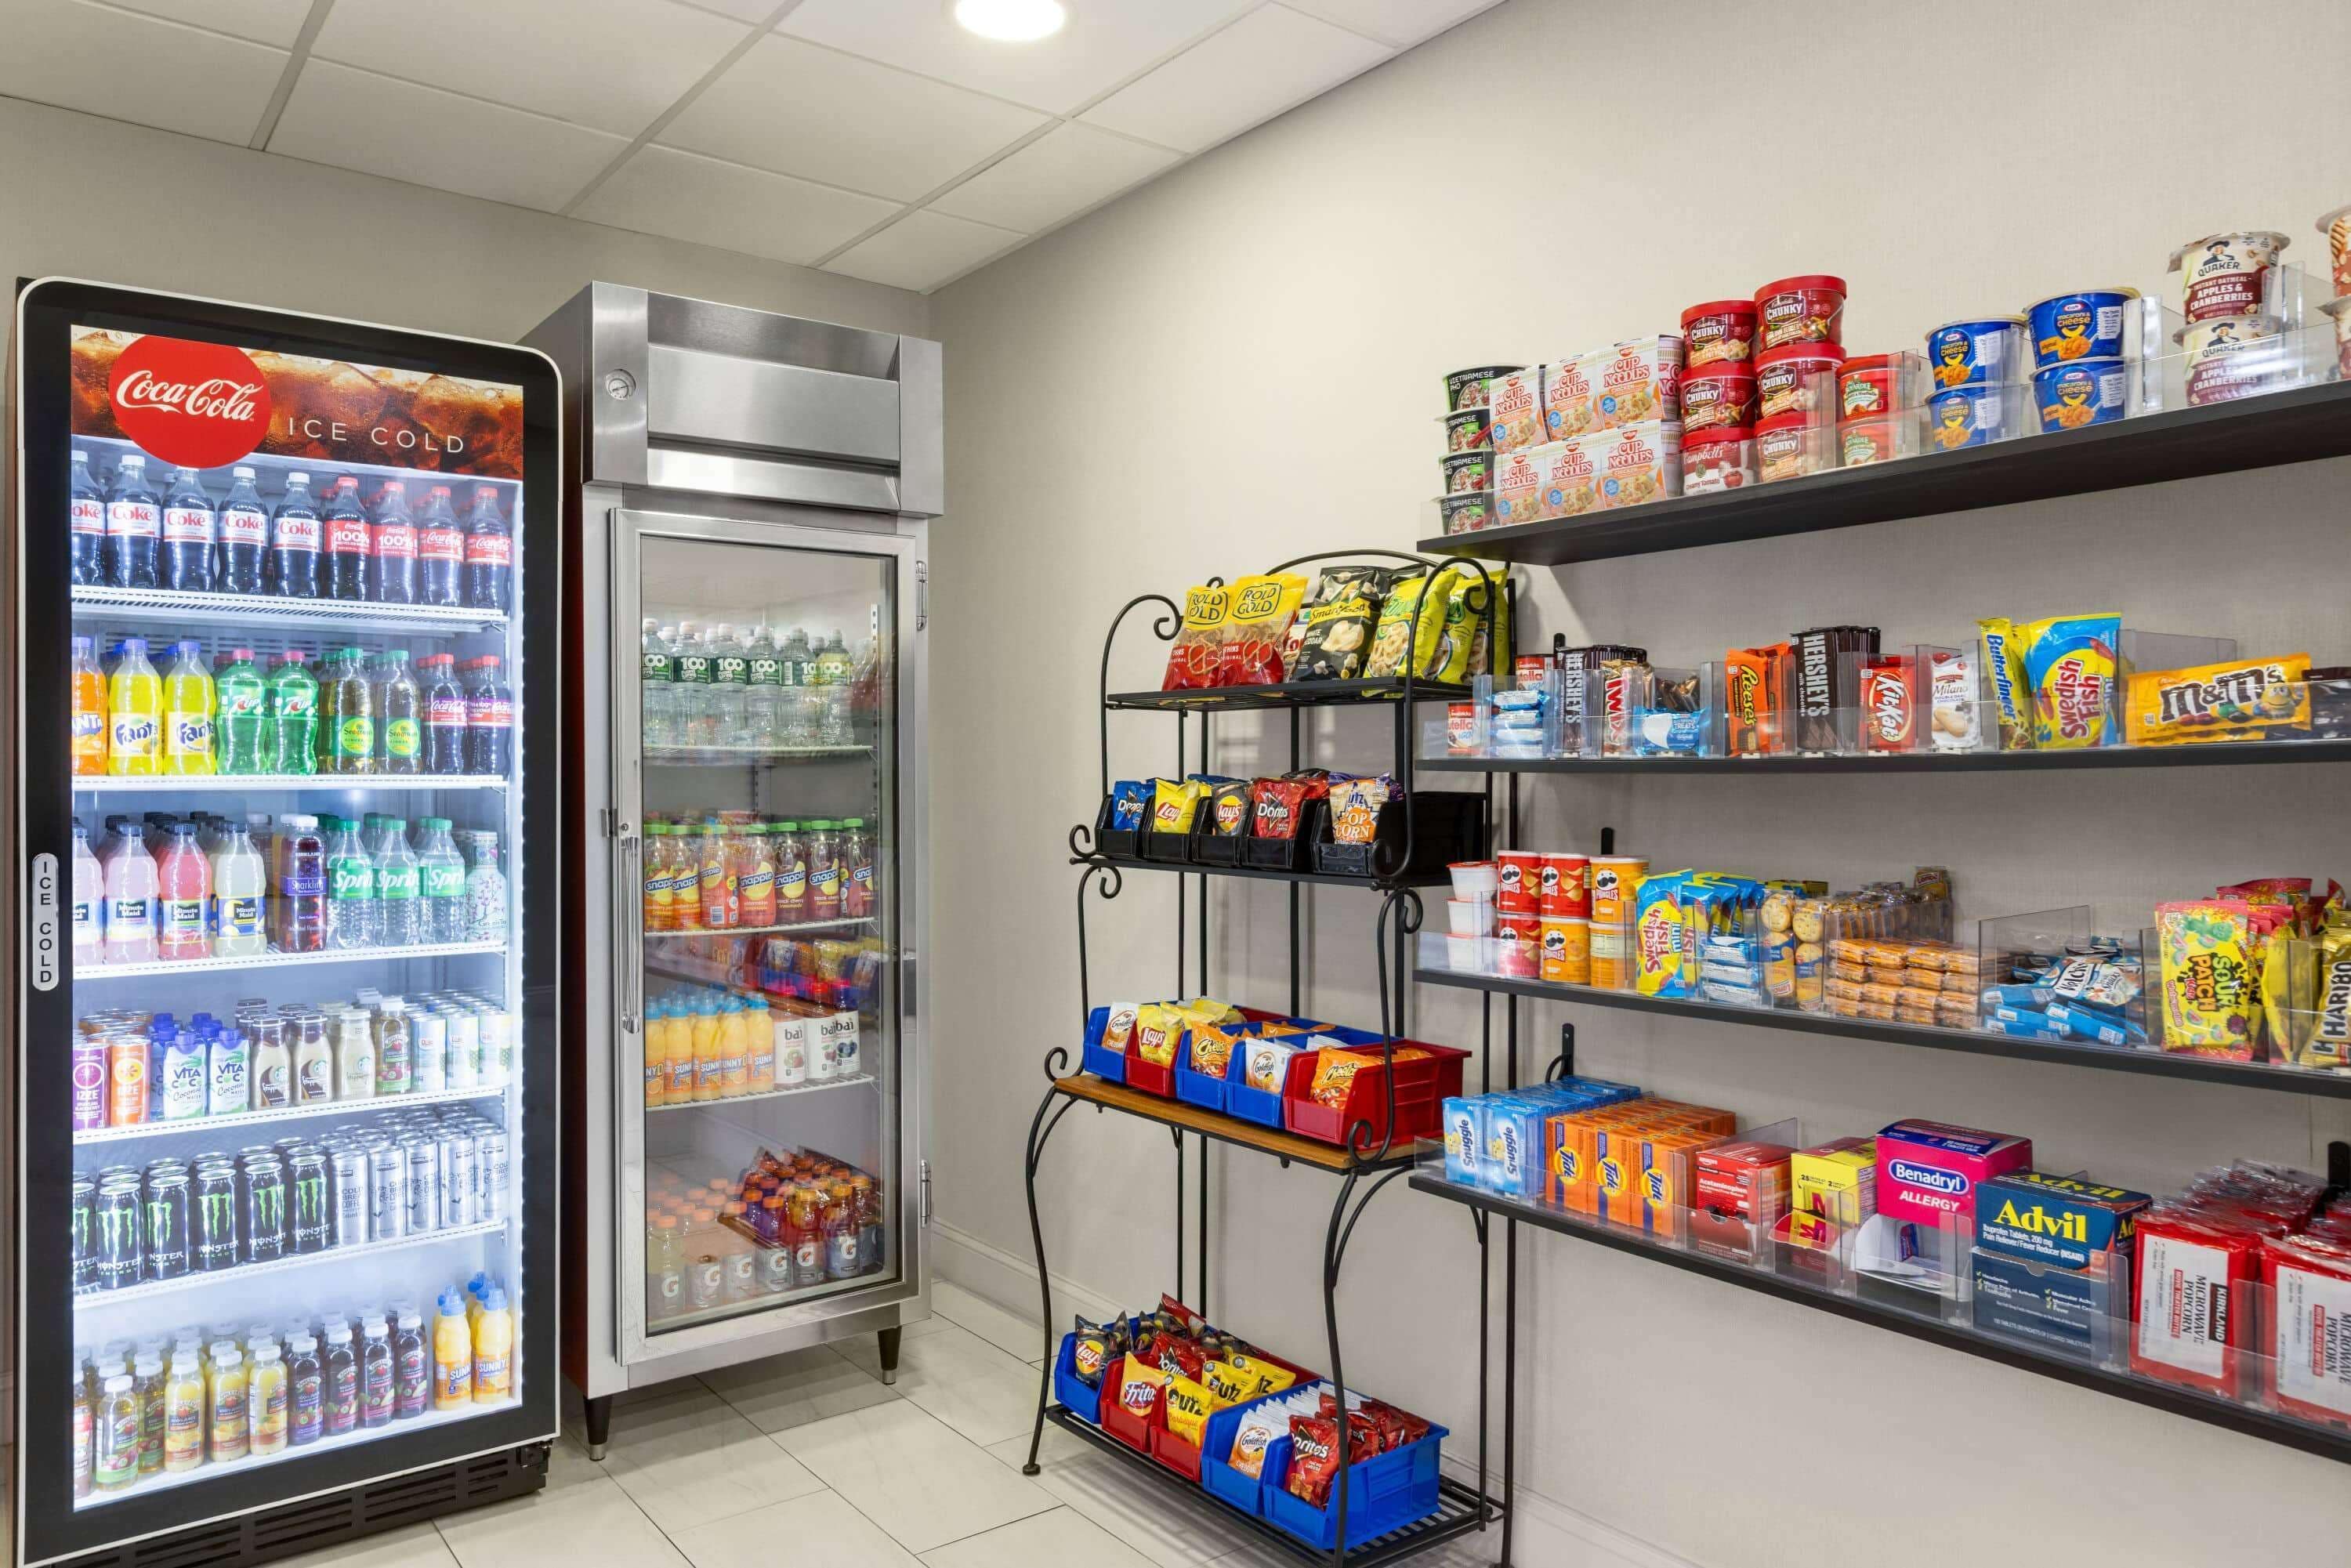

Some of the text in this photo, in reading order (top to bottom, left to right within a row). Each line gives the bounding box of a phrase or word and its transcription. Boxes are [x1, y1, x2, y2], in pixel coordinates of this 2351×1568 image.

[2198, 262, 2241, 277] QUAKER
[2218, 276, 2248, 285] OATMEAL
[2197, 283, 2243, 299] APPLES &
[1766, 302, 1803, 320] CHUNKY
[2190, 293, 2254, 310] CRANBERRIES
[1692, 325, 1725, 340] CHUNKY
[1614, 356, 1639, 373] CUP
[2201, 367, 2233, 379] APPLE
[1449, 371, 1495, 385] VIETNAMESE
[1559, 372, 1581, 389] CUP
[1604, 365, 1650, 387] NOODLES
[1762, 374, 1794, 390] CHUNKY
[116, 370, 264, 422] Coca-Cola
[1502, 387, 1524, 403] CUP
[1550, 381, 1589, 402] NOODLES
[1686, 390, 1718, 404] CHUNKY
[1494, 394, 1534, 416] NOODLES
[288, 416, 465, 454] ICE COLD
[1617, 440, 1643, 456] CUP
[1763, 440, 1797, 454] CHUNKY
[1561, 452, 1585, 468] CUP
[1608, 448, 1654, 469] NOODLES
[1509, 465, 1531, 478] CUP
[1552, 460, 1593, 480] NOODLES
[1501, 473, 1539, 491] NOODLES
[72, 504, 100, 519] oke
[112, 505, 152, 522] Coke
[166, 511, 205, 528] Coke
[225, 513, 264, 531] Coke
[279, 520, 314, 536] Coke
[1242, 588, 1277, 601] ROLD
[1237, 600, 1273, 615] GOLD
[680, 657, 706, 672] 100
[717, 657, 744, 672] 100
[750, 659, 776, 673] 100
[1803, 634, 1831, 716] HERSHEY'S
[1987, 633, 2016, 720] Butterfinger
[1566, 653, 1584, 723] HERSHEY'S
[1741, 664, 1760, 726] Reese's
[1933, 684, 1968, 697] Milano
[2054, 658, 2102, 739] Swedish Fish
[1607, 679, 1625, 744] TWIX
[179, 720, 215, 744] Fanta
[1217, 806, 1242, 823] Lay's
[39, 861, 52, 983] ICE COLD
[1645, 907, 1670, 974] Swedish Fish
[1671, 923, 1682, 952] mini
[2192, 955, 2217, 1012] PATCH
[2213, 956, 2234, 1006] SOUR
[2322, 961, 2351, 1036] HARIBO
[784, 1027, 802, 1041] bai
[820, 1022, 837, 1036] bai
[836, 1018, 854, 1031] bai
[1142, 1027, 1166, 1048] Lay's
[174, 1067, 201, 1080] VITA
[218, 1062, 245, 1074] VITA
[1255, 1060, 1275, 1074] Goldfish
[1458, 1119, 1475, 1168] Snuggle
[1503, 1126, 1518, 1177] Snuggle
[1560, 1146, 1577, 1178] Tide
[1603, 1159, 1620, 1189] Tide
[1896, 1163, 1960, 1193] Benadryl
[1648, 1171, 1663, 1201] Tide
[1699, 1178, 1748, 1194] Acetaminophen
[1900, 1190, 1961, 1212] ALLERGY
[1994, 1199, 2088, 1243] Advil
[1983, 1223, 2009, 1237] Ibuprofen
[2031, 1235, 2042, 1244] 200
[2043, 1238, 2053, 1248] mg
[1983, 1231, 1996, 1240] Pain
[2036, 1244, 2060, 1256] Reducer
[2181, 1280, 2193, 1334] POPCORN
[2193, 1274, 2207, 1345] MICROWAVE
[2215, 1287, 2228, 1342] KIRKLAND
[2325, 1316, 2338, 1373] POPCORN
[1216, 1381, 1241, 1402] utz
[1178, 1396, 1204, 1416] utz
[1241, 1433, 1268, 1447] Goldfish
[1292, 1432, 1330, 1458] oritos
